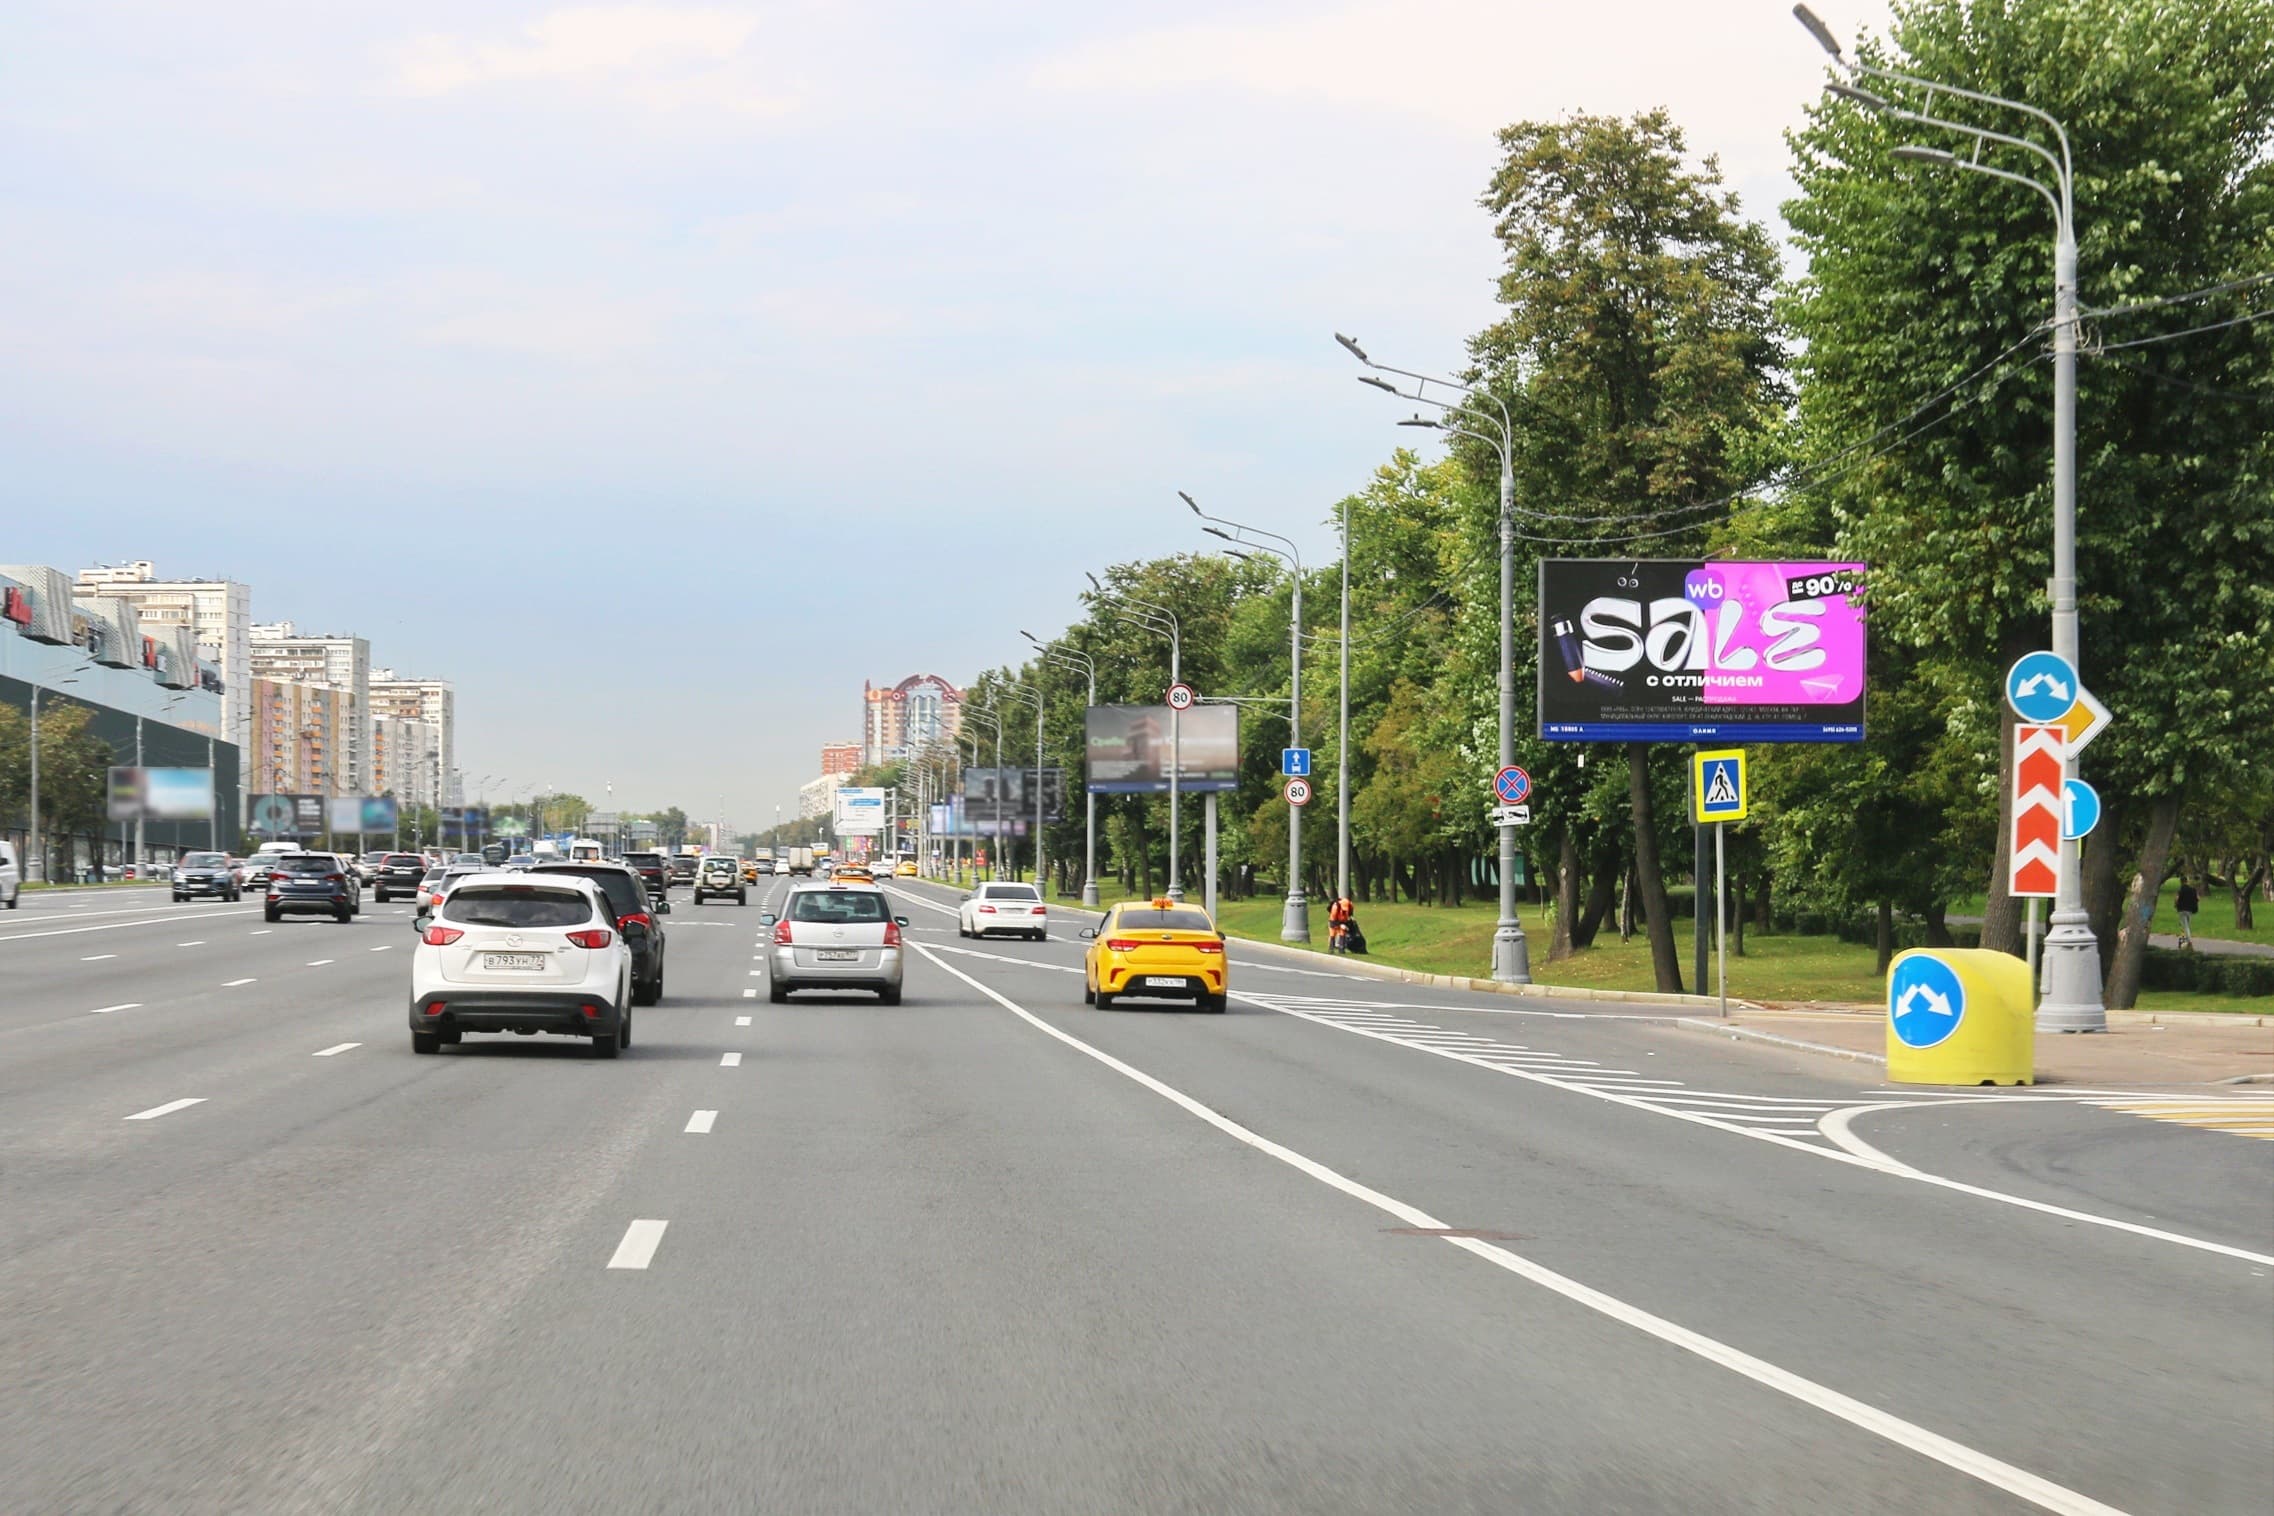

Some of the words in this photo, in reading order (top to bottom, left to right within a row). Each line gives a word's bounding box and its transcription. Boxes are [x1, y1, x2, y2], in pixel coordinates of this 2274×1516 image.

[1687, 577, 1723, 599] wb
[1662, 676, 1763, 687] отличием
[1173, 692, 1187, 703] 80
[1290, 786, 1305, 797] 80
